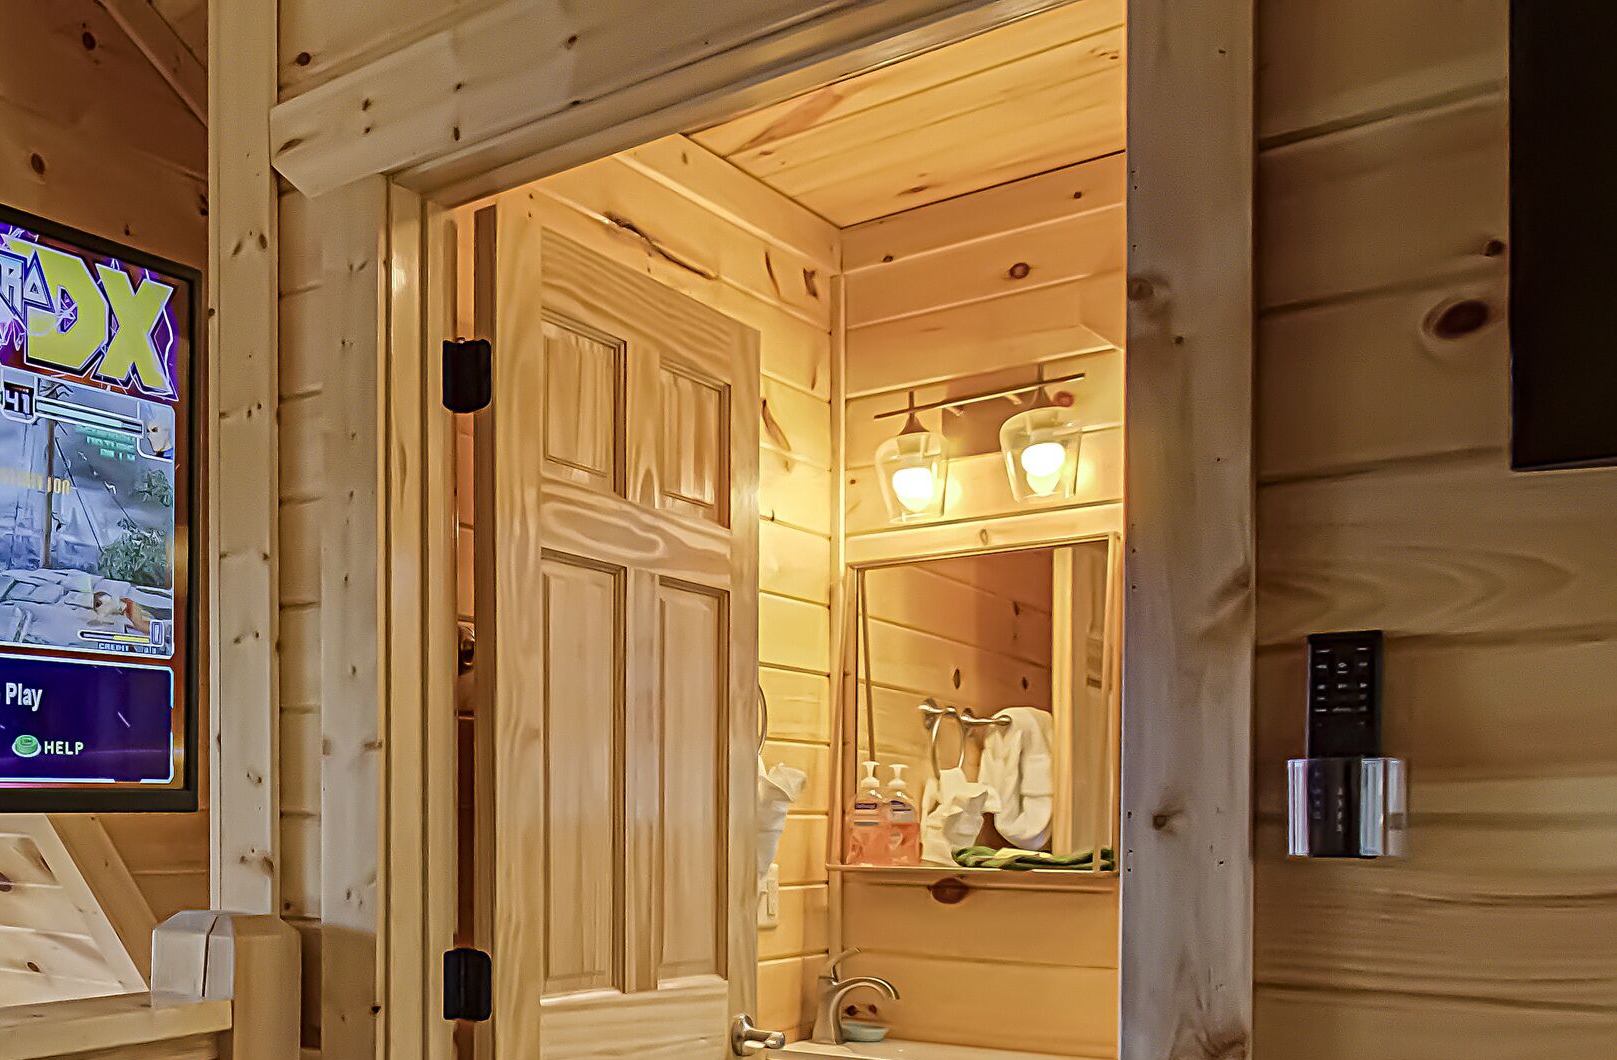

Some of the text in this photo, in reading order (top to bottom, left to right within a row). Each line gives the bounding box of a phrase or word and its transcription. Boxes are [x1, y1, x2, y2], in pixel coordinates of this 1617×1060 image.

[10, 239, 176, 397] DX
[5, 682, 43, 712] Play
[44, 740, 84, 756] HELP
